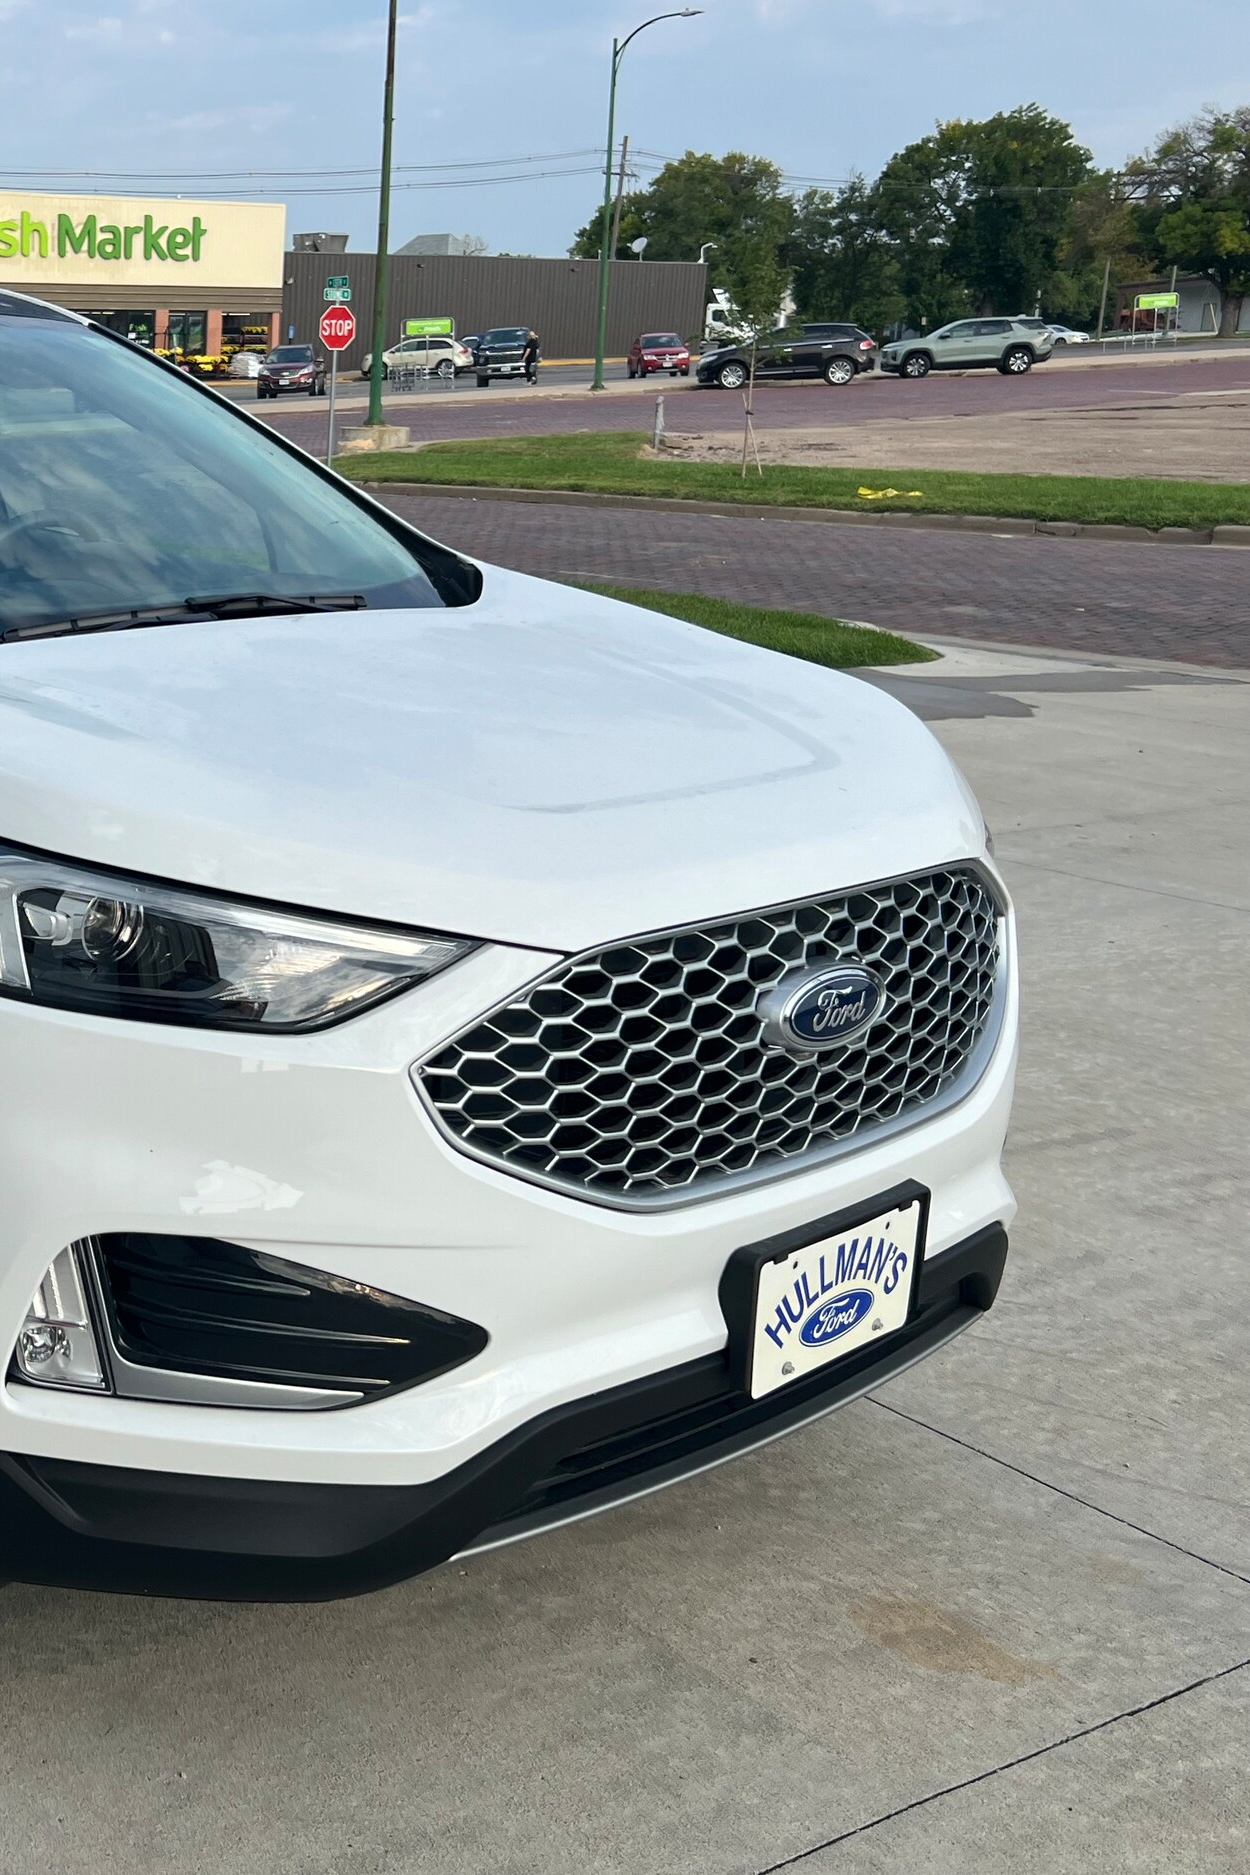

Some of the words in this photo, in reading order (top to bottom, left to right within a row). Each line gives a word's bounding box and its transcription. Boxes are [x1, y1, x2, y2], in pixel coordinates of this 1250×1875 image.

[57, 213, 208, 262] Market
[322, 319, 352, 336] STOP
[813, 986, 866, 1032] Ford
[764, 1236, 908, 1350] HULLMAN'S
[812, 1297, 860, 1338] Ford
